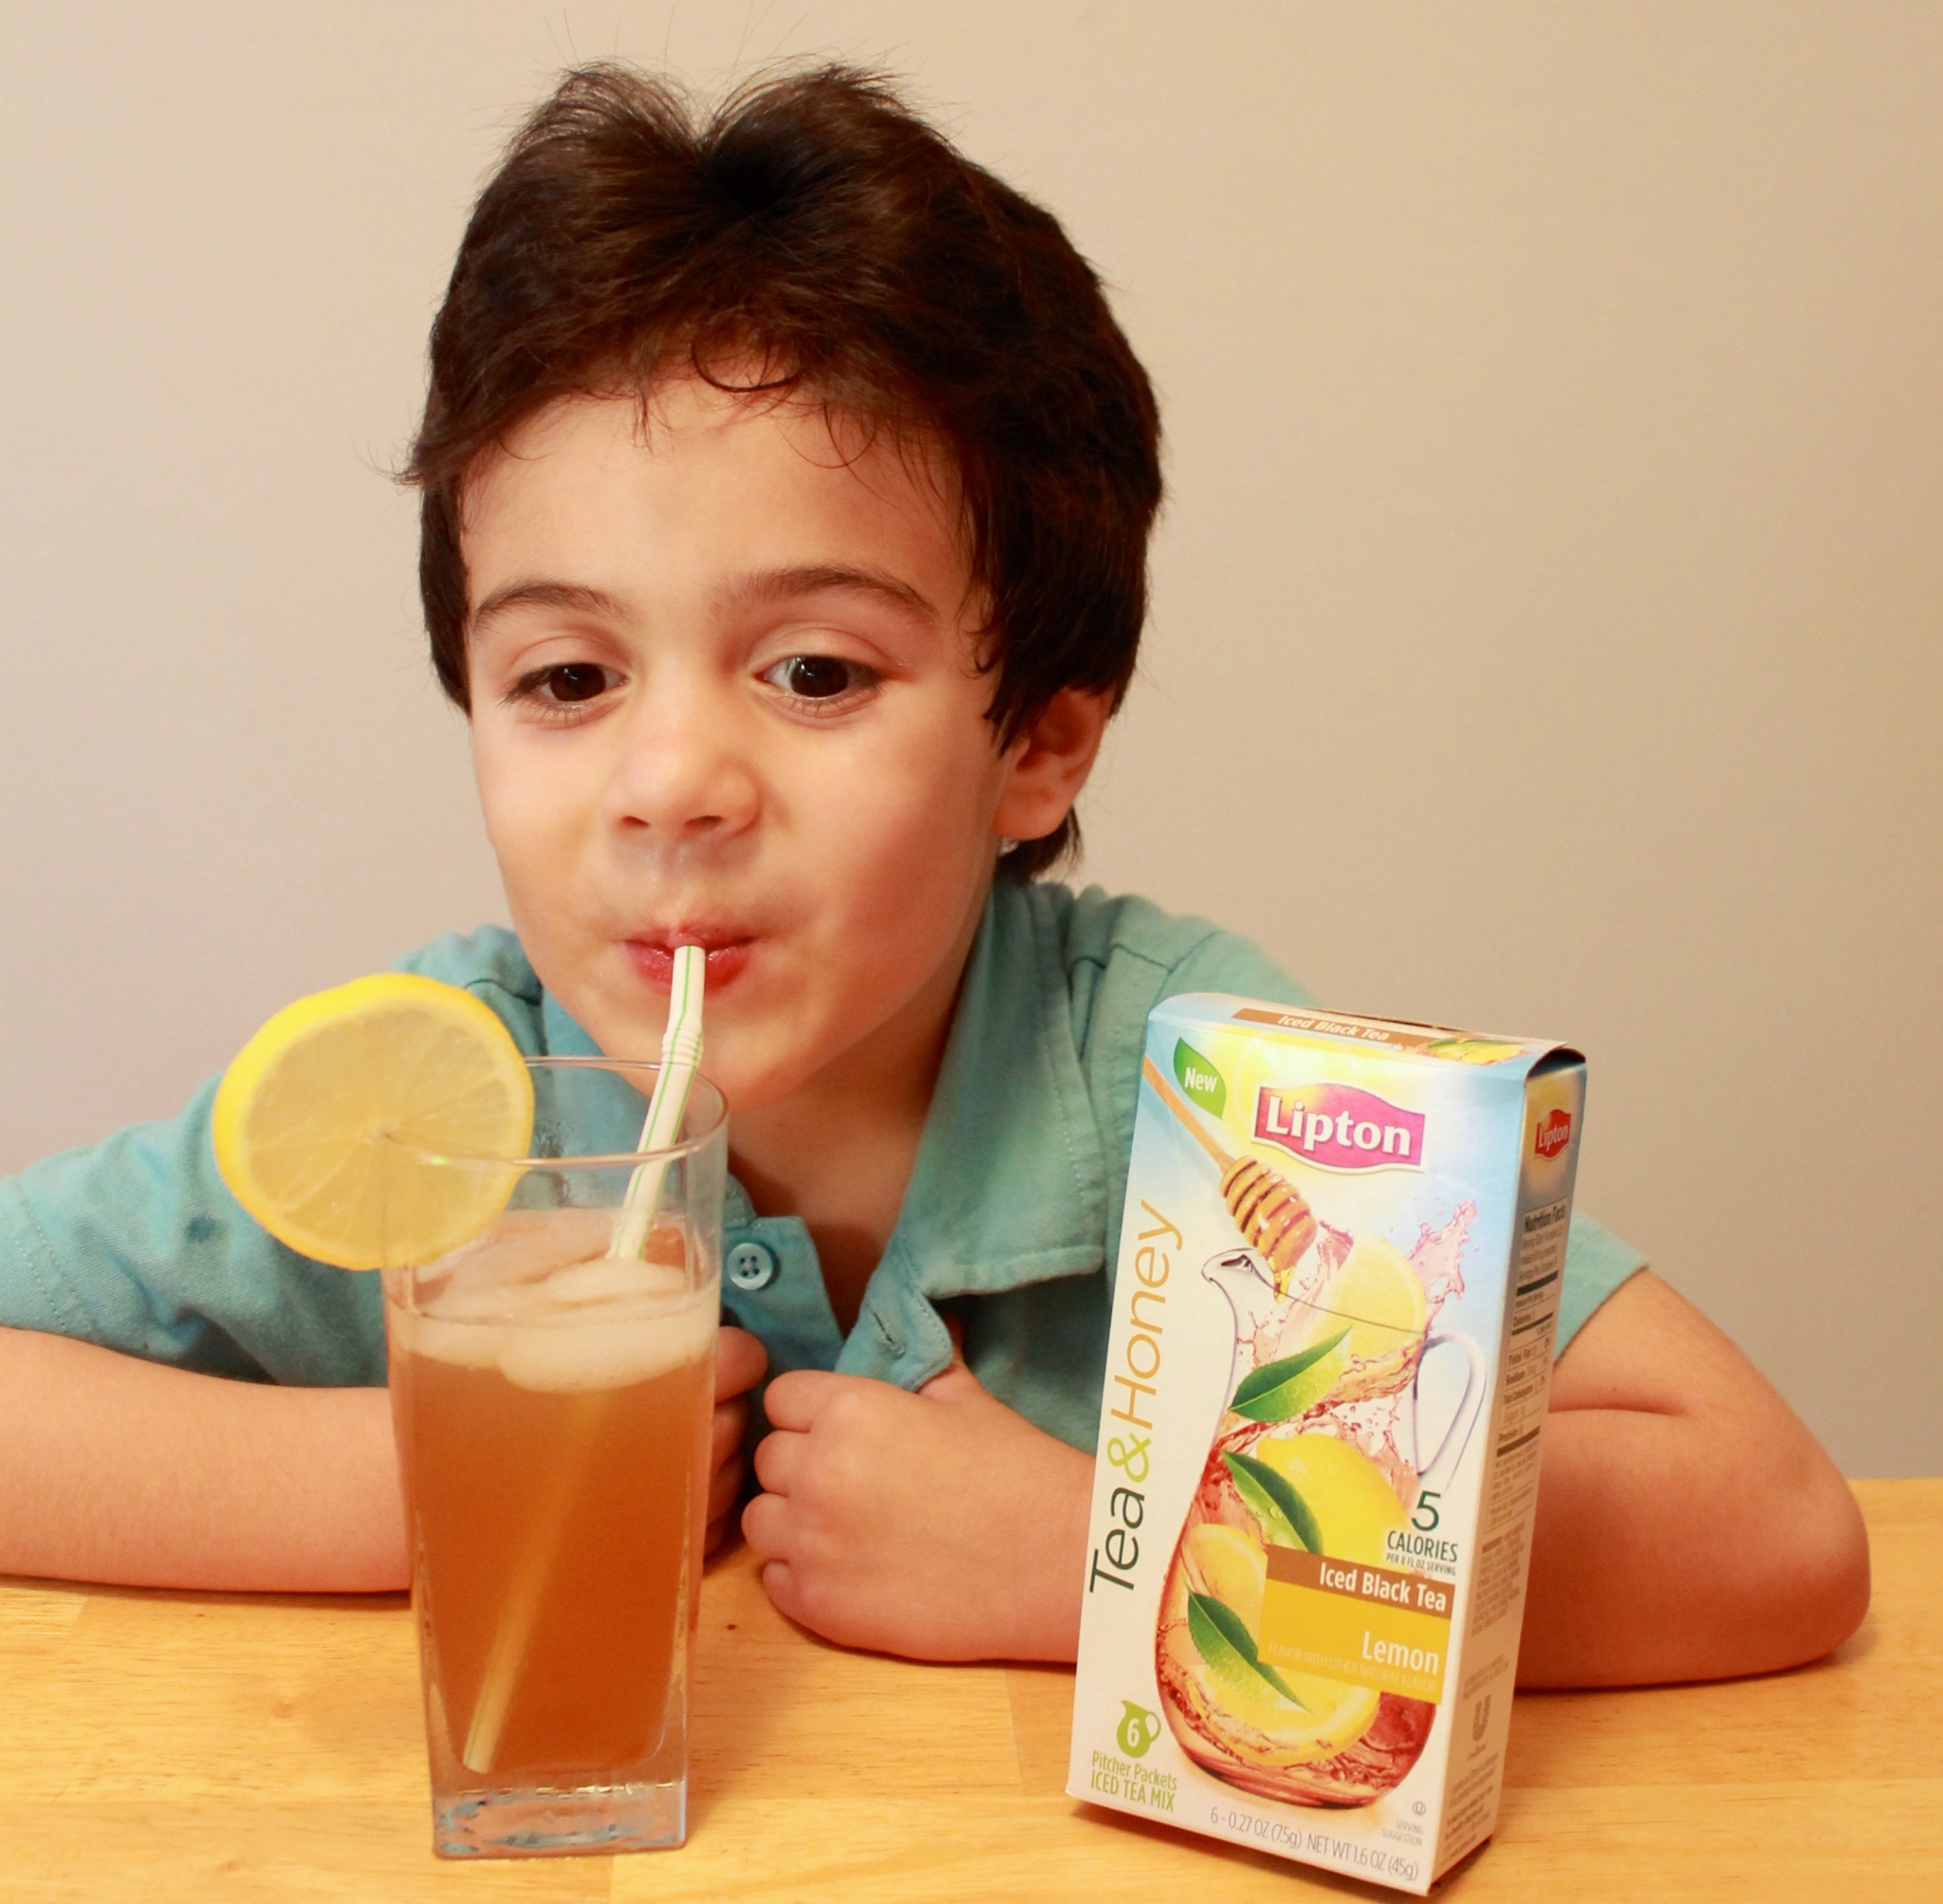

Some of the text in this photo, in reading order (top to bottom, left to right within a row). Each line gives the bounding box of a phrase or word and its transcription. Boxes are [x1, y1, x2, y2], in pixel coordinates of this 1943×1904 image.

[1277, 1015, 1390, 1041] Iced Black Tea
[1183, 1065, 1217, 1094] New
[1266, 1095, 1412, 1156] Lipton
[1539, 1123, 1568, 1152] Lipton
[1411, 1489, 1441, 1532] 5
[1387, 1530, 1458, 1563] CALORIES
[1386, 1552, 1399, 1563] PER
[1407, 1556, 1415, 1567] FL
[1416, 1559, 1425, 1569] OZ
[1427, 1561, 1456, 1576] SERVING
[1319, 1562, 1447, 1613] Iced Black Tea
[1361, 1631, 1439, 1675] Lemon
[1126, 1717, 1139, 1748] 6
[1092, 1749, 1177, 1790] Pitcher Packets
[1091, 1769, 1175, 1812] ICED TEA MIX
[1210, 1806, 1218, 1824] 6
[1229, 1811, 1252, 1833] 0.27
[1253, 1821, 1269, 1839] OZ
[1307, 1833, 1329, 1856] NET
[1331, 1839, 1351, 1861] WT
[1353, 1845, 1368, 1866] 1.6
[1370, 1850, 1387, 1871] OZ
[1388, 1855, 1418, 1881] (45g)
[1381, 1827, 1422, 1846] SUGGESTION
[1396, 1819, 1423, 1836] SERVING
